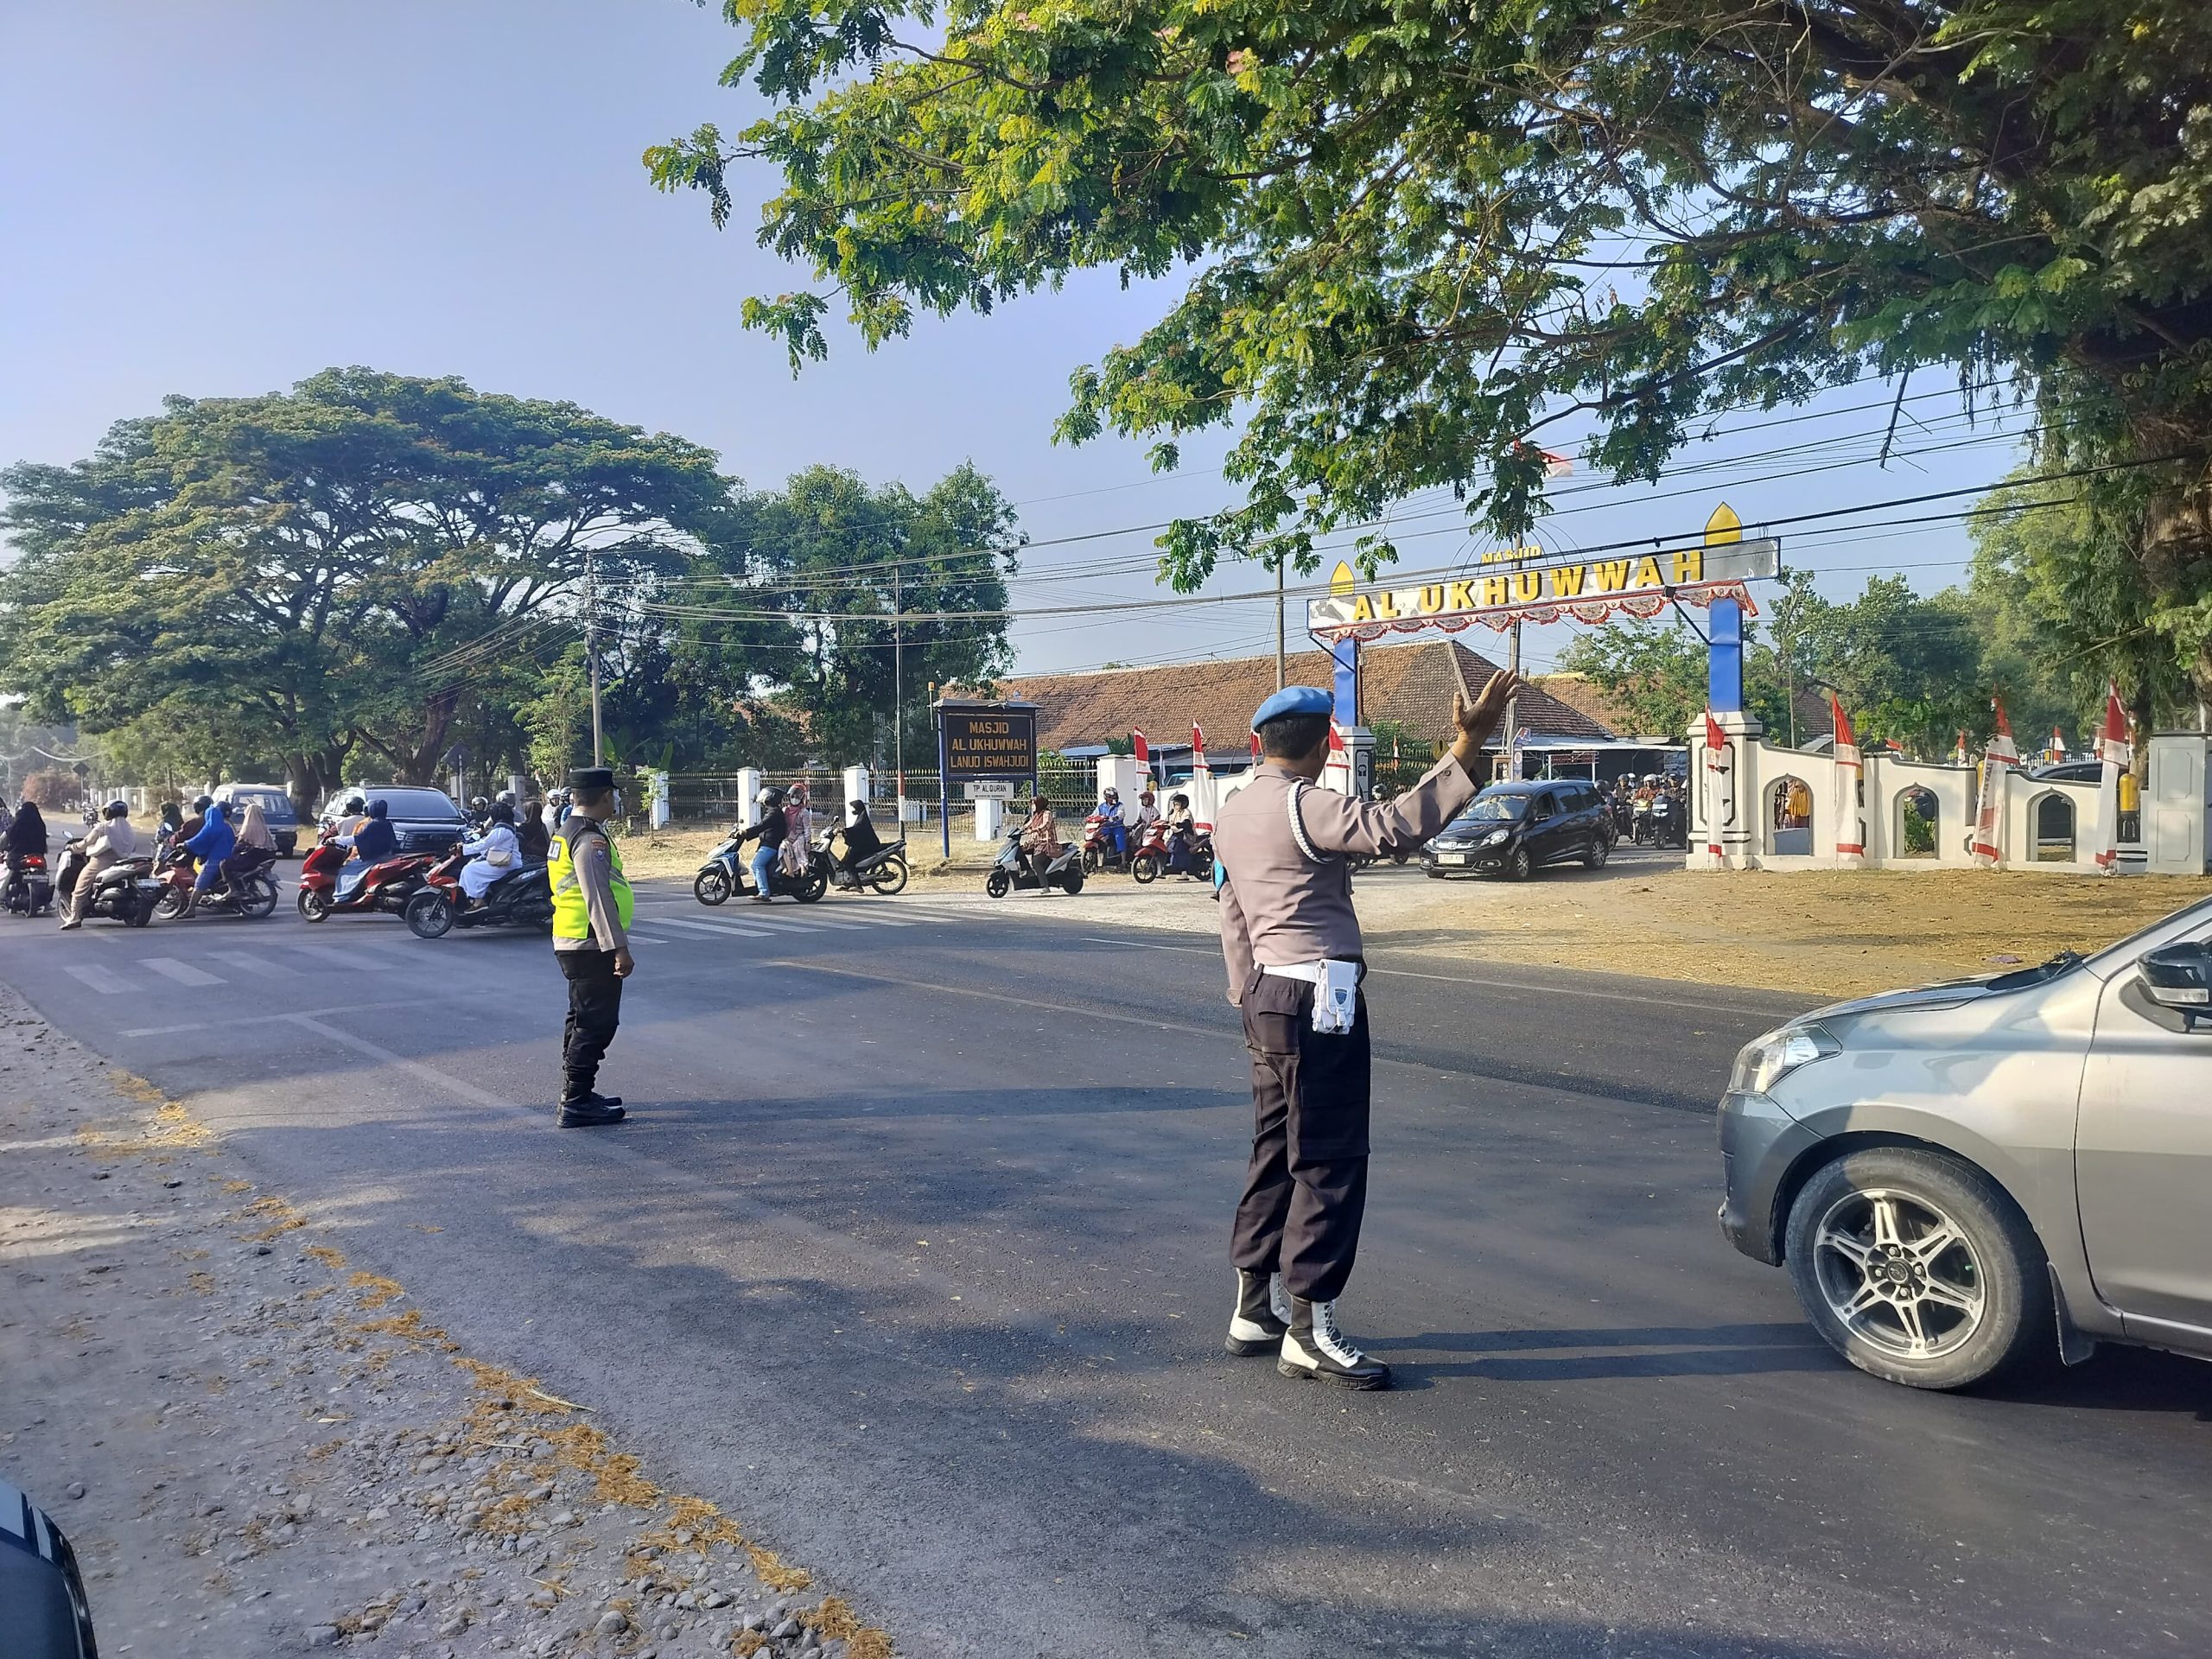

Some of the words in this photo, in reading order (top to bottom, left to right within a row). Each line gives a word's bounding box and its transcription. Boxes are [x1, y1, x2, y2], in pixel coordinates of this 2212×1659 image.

[1481, 546, 1541, 563] MASJID
[1354, 593, 1401, 620] AL
[1420, 550, 1704, 613] UKHUWWAH
[969, 722, 1009, 734] MASJID
[952, 739, 967, 750] AL
[969, 738, 1027, 750] UKHUWWAH
[950, 755, 981, 767] LANUD
[984, 755, 1028, 767] ISWAHJUDI
